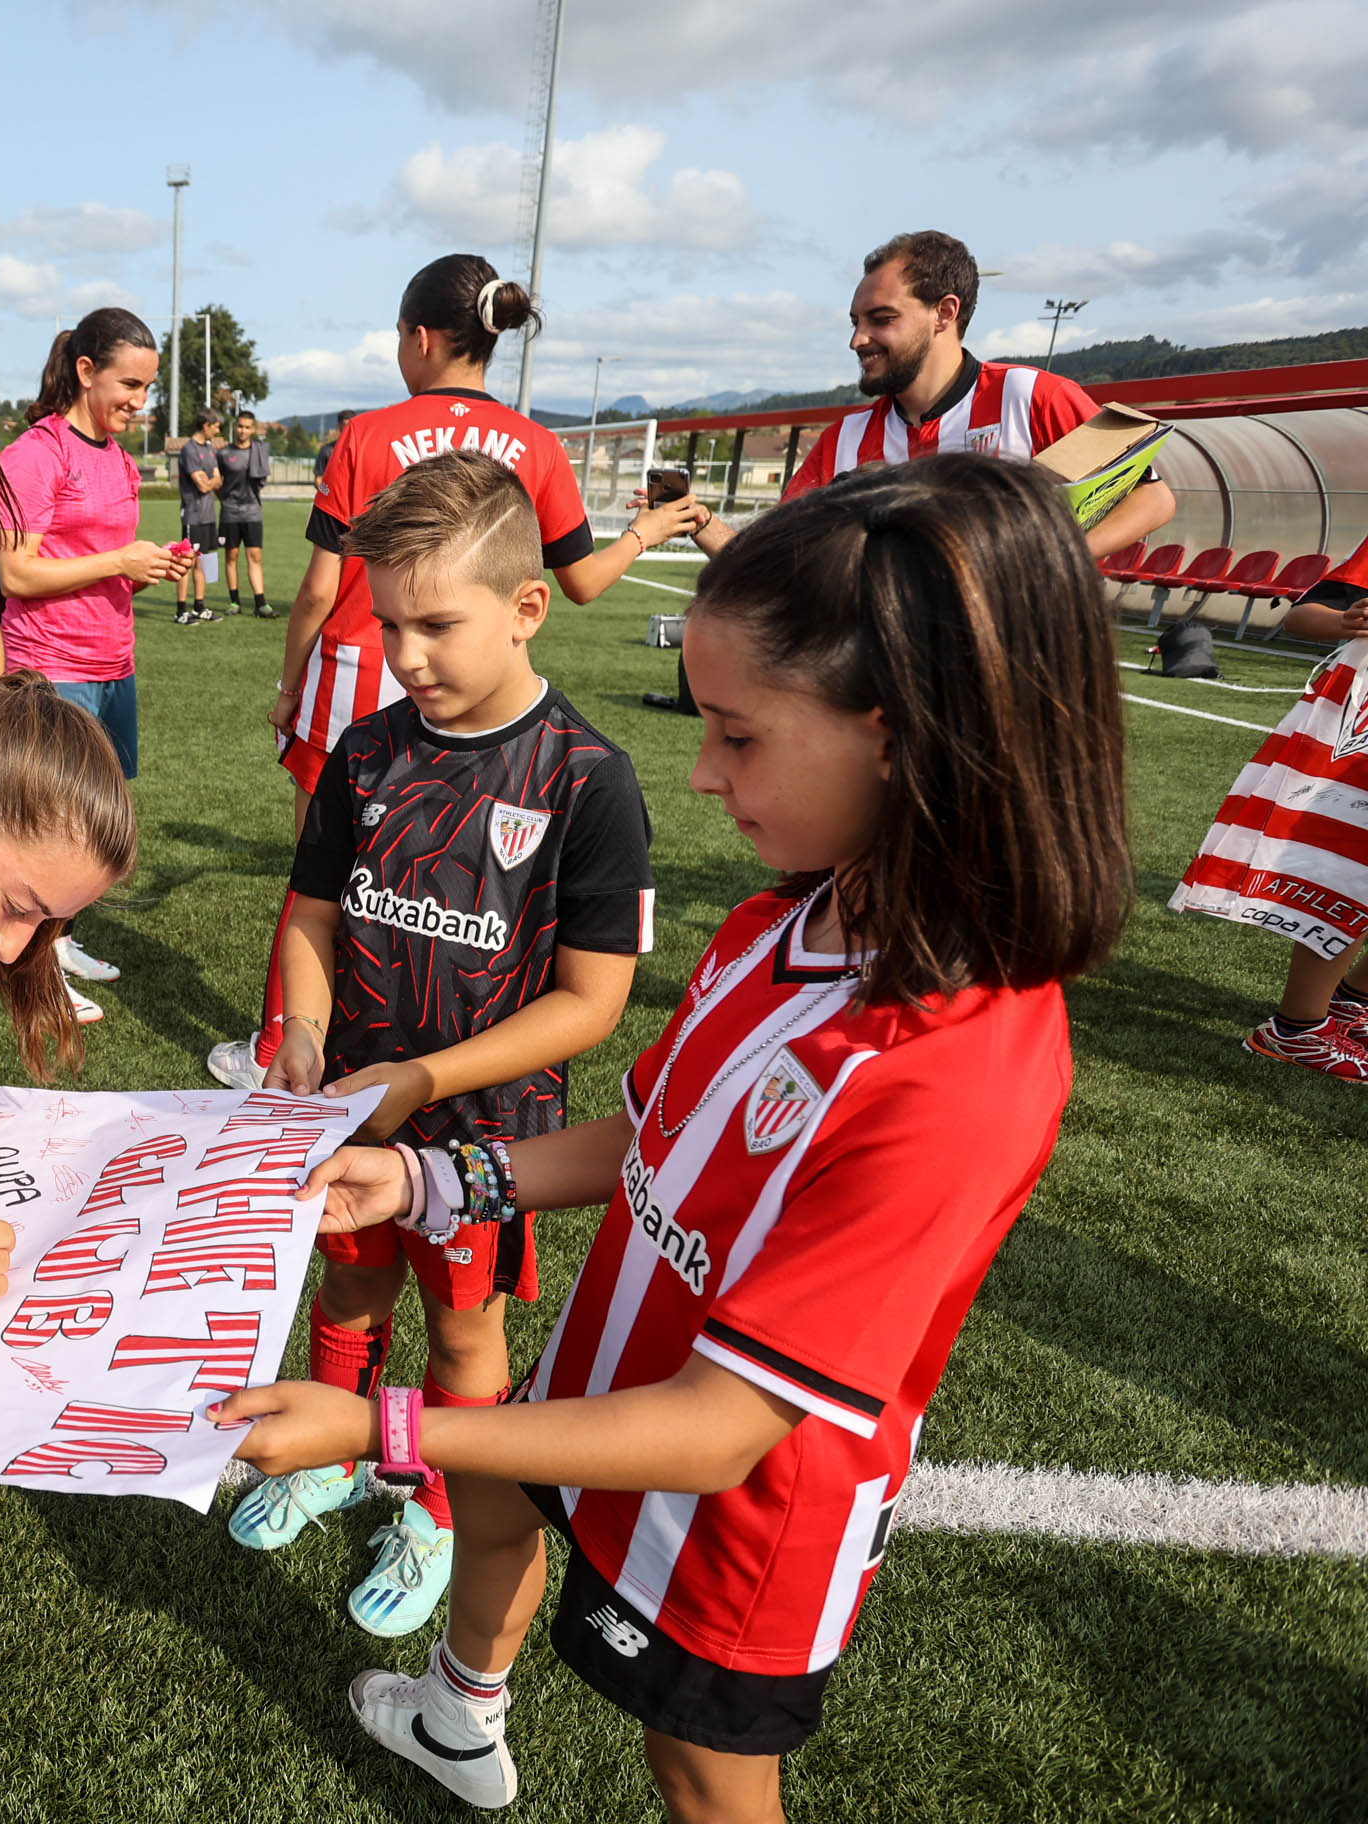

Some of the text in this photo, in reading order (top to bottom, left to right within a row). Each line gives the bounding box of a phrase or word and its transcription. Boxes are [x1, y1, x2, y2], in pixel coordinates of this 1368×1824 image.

[390, 426, 527, 470] NEKANE
[498, 809, 544, 824] ATHLETIC CLUB
[499, 847, 523, 865] BILBAO
[1, 1134, 188, 1350] CLUB
